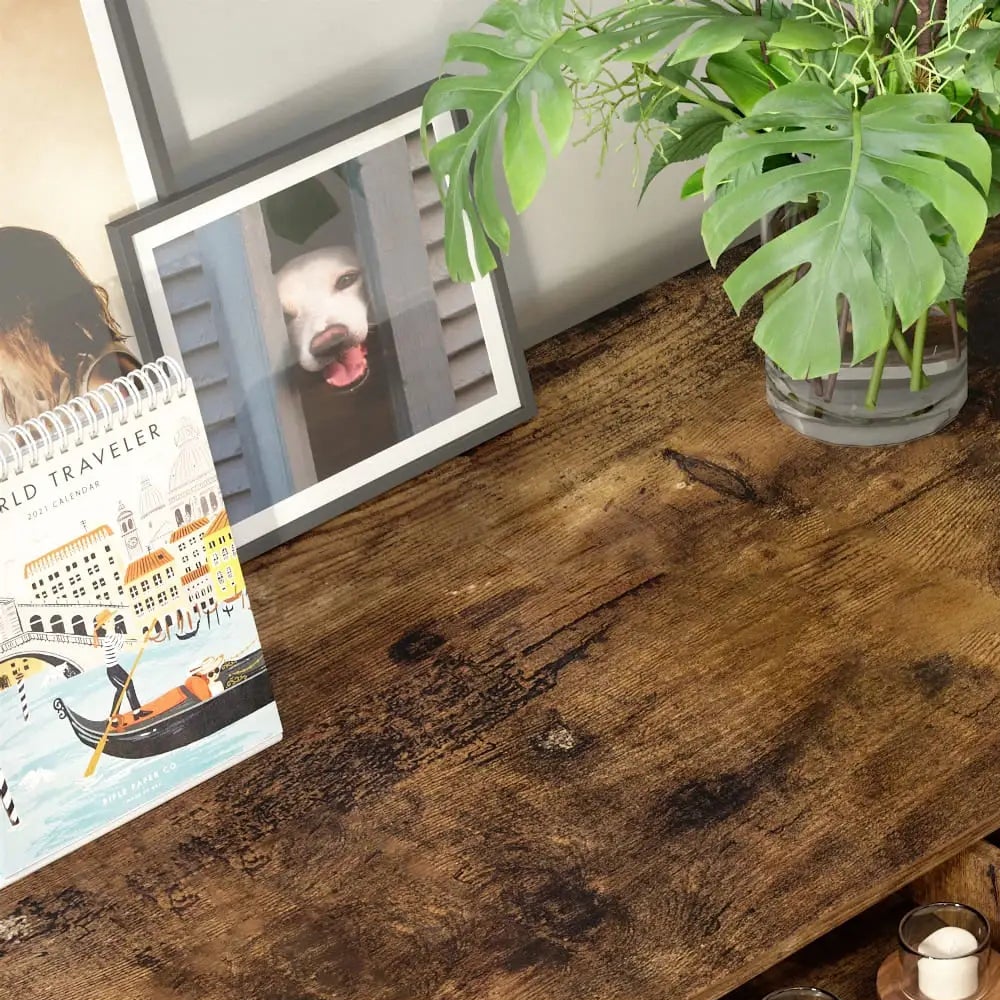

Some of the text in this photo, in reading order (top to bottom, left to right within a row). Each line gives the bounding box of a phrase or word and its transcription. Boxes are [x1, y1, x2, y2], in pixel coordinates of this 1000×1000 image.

[48, 423, 161, 487] TRAVELER
[27, 480, 101, 521] 2021 CALENDAR
